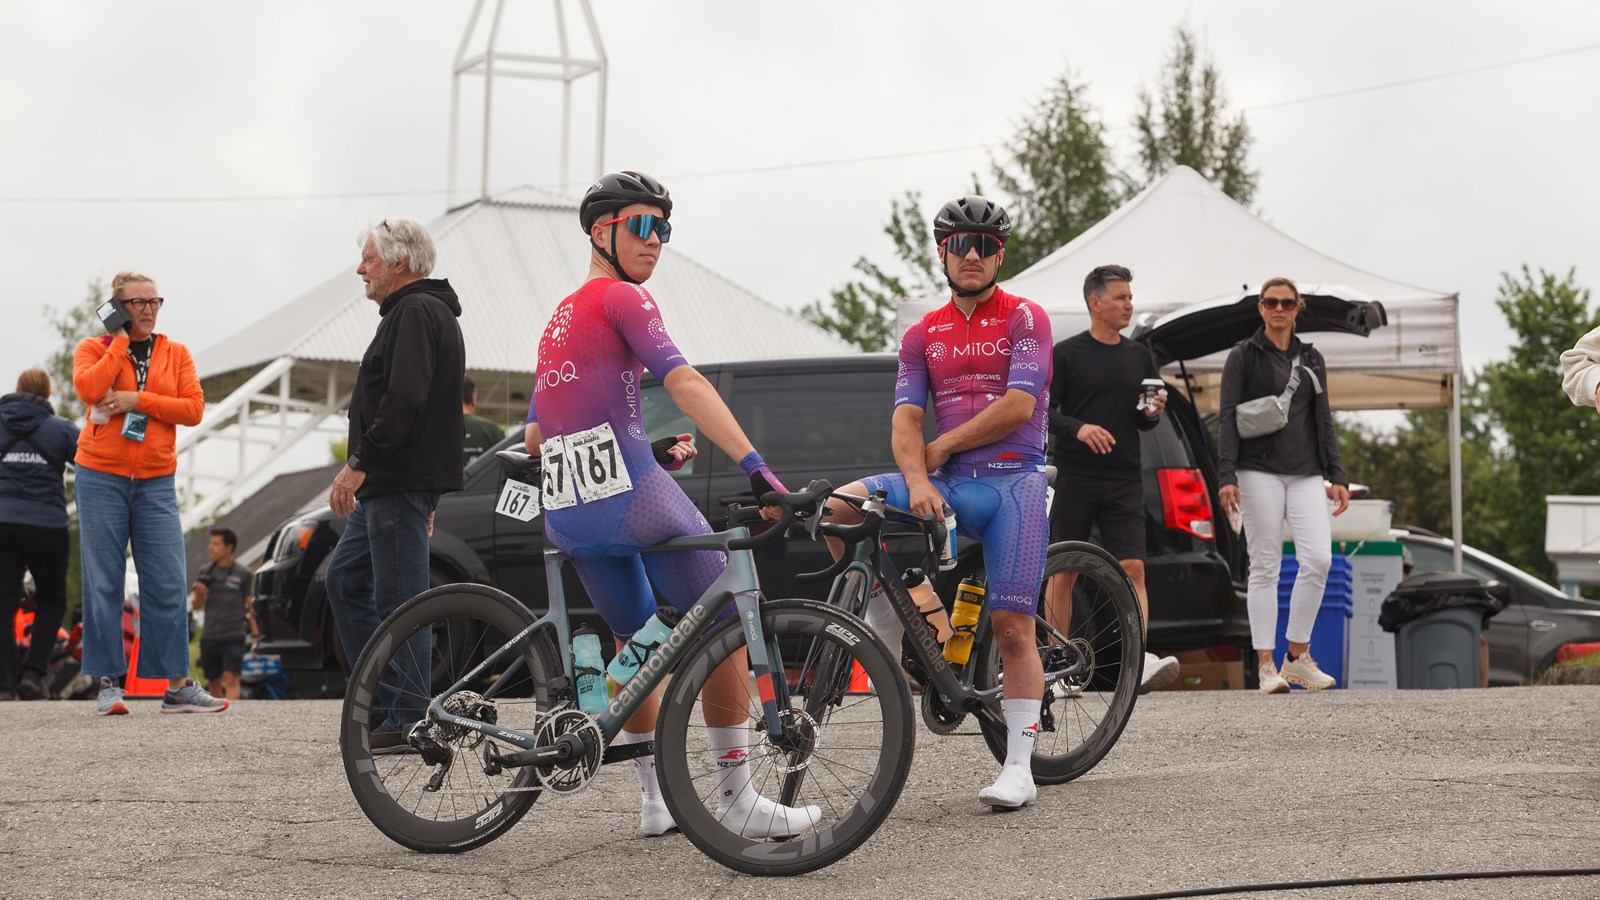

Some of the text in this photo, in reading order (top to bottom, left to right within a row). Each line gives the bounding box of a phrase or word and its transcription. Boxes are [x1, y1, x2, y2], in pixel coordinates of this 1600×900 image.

[574, 439, 618, 488] 167
[502, 490, 531, 516] 167
[609, 604, 707, 717] cannondale
[454, 719, 482, 730] SRAM
